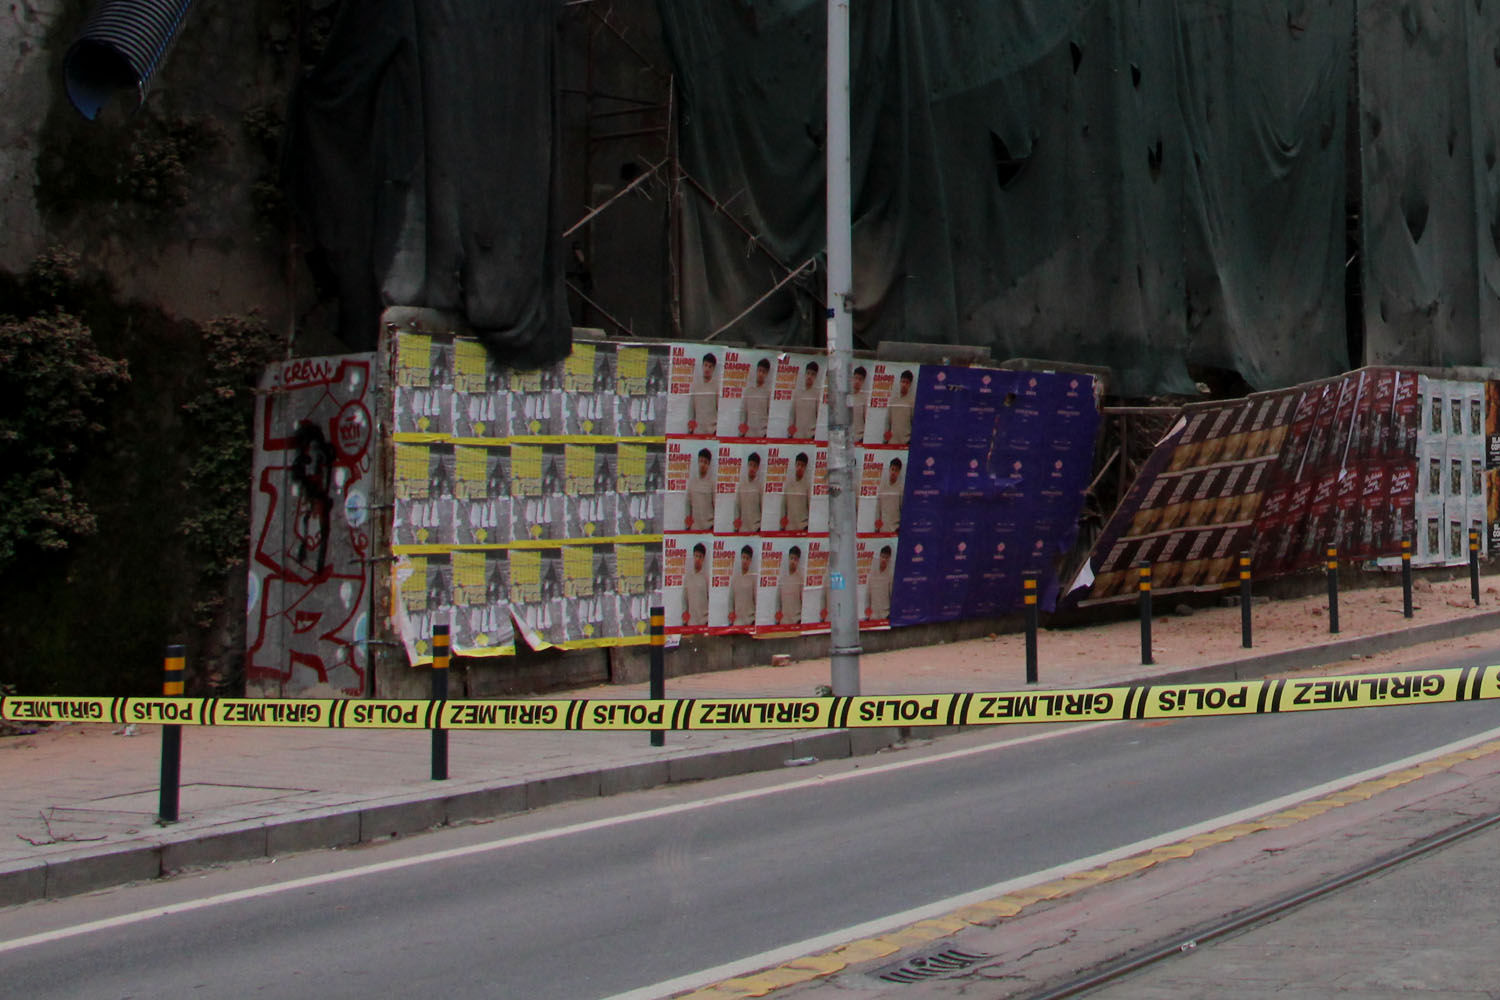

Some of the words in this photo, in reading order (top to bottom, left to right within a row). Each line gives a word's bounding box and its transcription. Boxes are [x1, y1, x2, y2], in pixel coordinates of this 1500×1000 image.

[672, 347, 684, 357] KAI
[725, 352, 738, 362] KAI
[284, 360, 328, 384] CREW
[875, 365, 886, 374] KAI
[671, 383, 679, 393] 15
[722, 387, 729, 398] 15
[774, 390, 781, 400] 15
[870, 398, 878, 407] 15
[669, 444, 680, 453] KAI
[719, 447, 730, 457] KAI
[768, 447, 779, 457] KAI
[816, 451, 827, 460] KAI
[864, 453, 874, 462] KAI
[668, 480, 675, 490] 15
[717, 483, 724, 493] 15
[765, 483, 773, 492] 15
[813, 485, 820, 495] 15
[860, 487, 868, 496] 15
[665, 539, 676, 548] KAI
[714, 541, 724, 550] KAI
[762, 542, 772, 550] KAI
[809, 542, 820, 550] KAI
[665, 576, 672, 586] 15
[712, 577, 720, 587] 15
[760, 577, 767, 587] 15
[806, 576, 814, 586] 15
[1293, 673, 1444, 704] GİRİLMEZ
[1159, 687, 1247, 711] POLİS
[10, 701, 102, 718] GİRİLMEZ
[860, 699, 939, 721] POLİS
[979, 693, 1113, 718] GİRİLMEZ
[133, 703, 192, 720] POLİS
[223, 703, 321, 722] GİRİLMEZ
[354, 705, 418, 723] POLİS
[450, 705, 557, 724] GİRİLMEZ
[594, 705, 664, 724] POLİS
[700, 703, 819, 723] GİRİLMEZ
